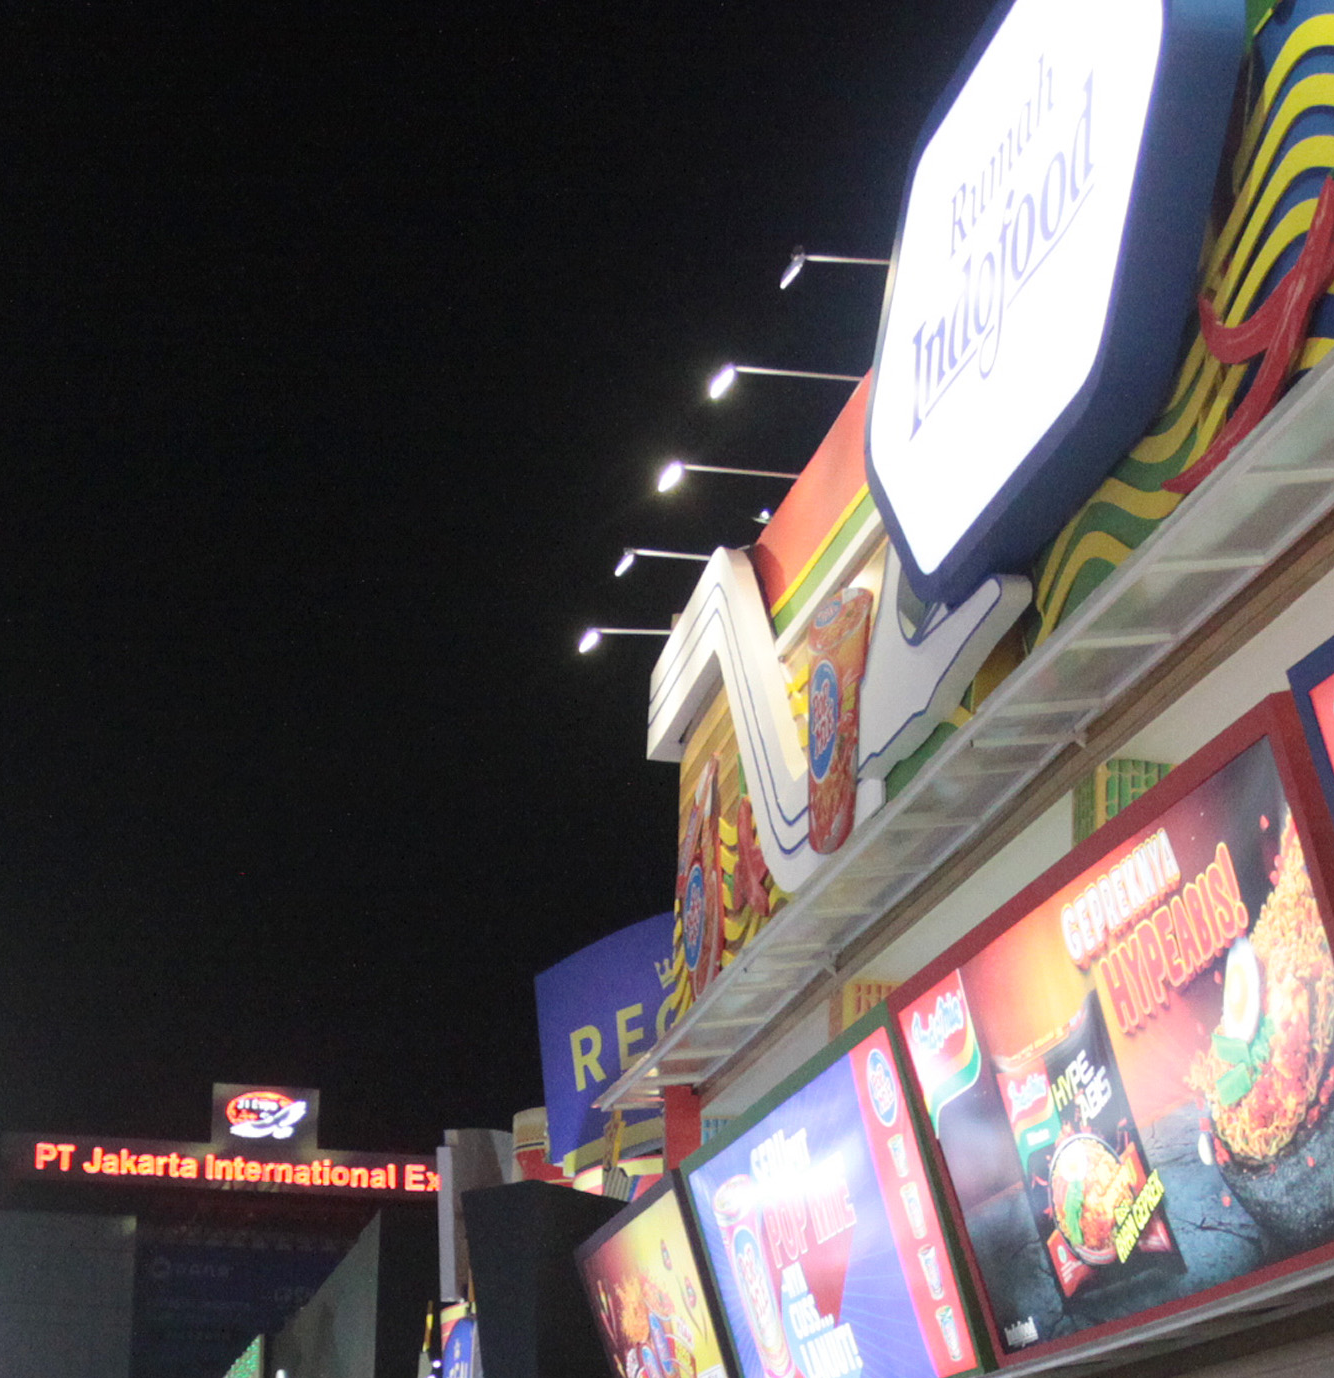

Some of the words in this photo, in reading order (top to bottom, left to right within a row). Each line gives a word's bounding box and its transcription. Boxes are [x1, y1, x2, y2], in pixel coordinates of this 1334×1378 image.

[950, 52, 1055, 258] Rumah
[909, 66, 1095, 442] Indofood
[1060, 828, 1181, 966] GEPREKNYA
[1098, 842, 1249, 1036] HYPEABIS!
[1051, 1049, 1094, 1112] HYPE
[35, 1142, 76, 1170] PT
[82, 1146, 199, 1179] Jakarta
[204, 1154, 397, 1190] International
